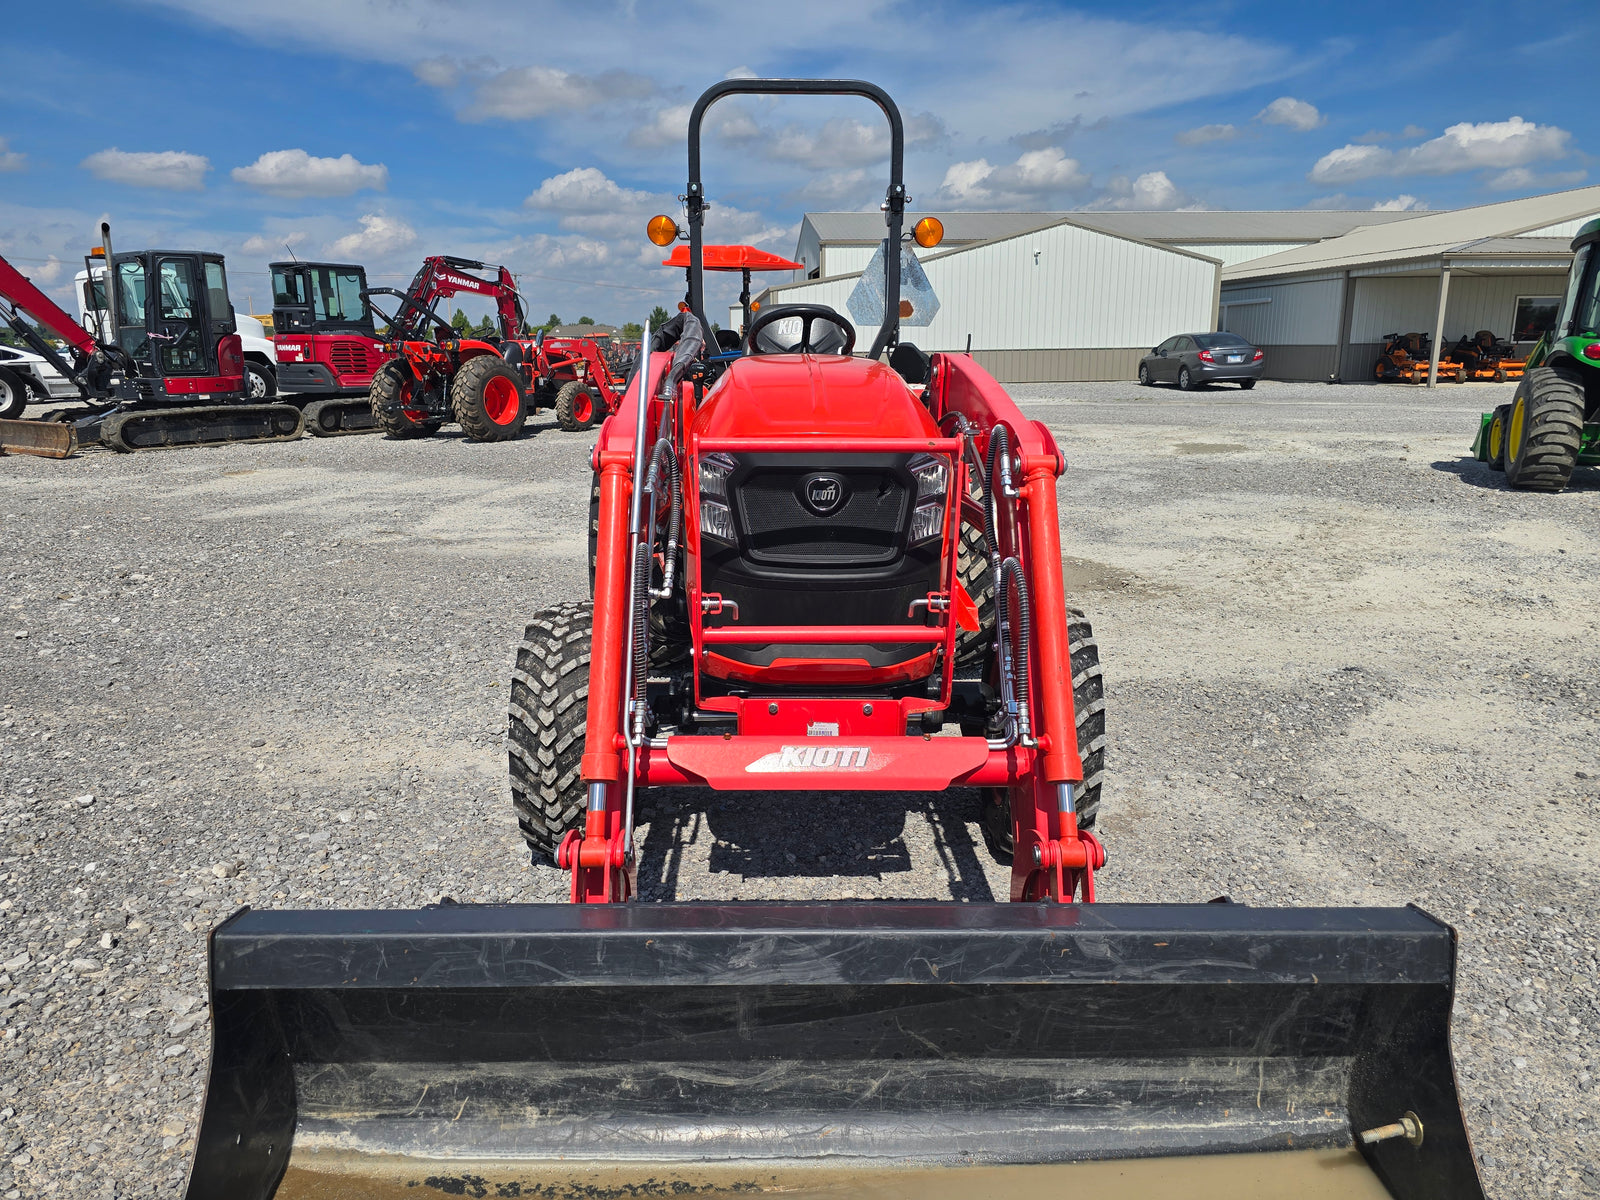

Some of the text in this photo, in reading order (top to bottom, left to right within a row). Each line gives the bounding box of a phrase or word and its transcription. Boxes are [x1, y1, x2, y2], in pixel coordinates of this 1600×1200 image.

[447, 275, 480, 290] YANMAR
[778, 320, 803, 335] KIO
[780, 746, 870, 767] KIOTI
